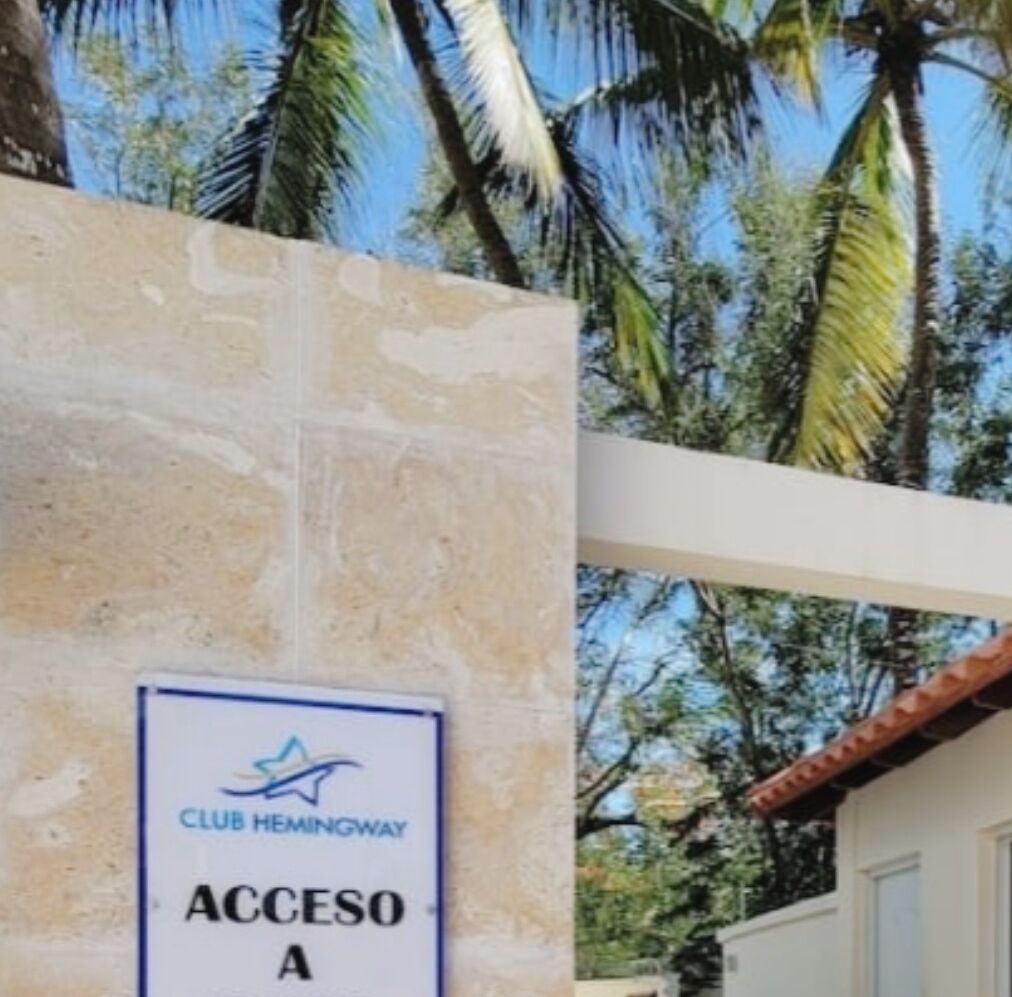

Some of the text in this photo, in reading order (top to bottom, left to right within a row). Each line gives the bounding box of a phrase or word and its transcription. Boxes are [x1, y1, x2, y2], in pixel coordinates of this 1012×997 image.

[179, 807, 409, 838] CLUB HEMINGWAY
[184, 883, 405, 928] ACCESO
[277, 943, 312, 981] A
